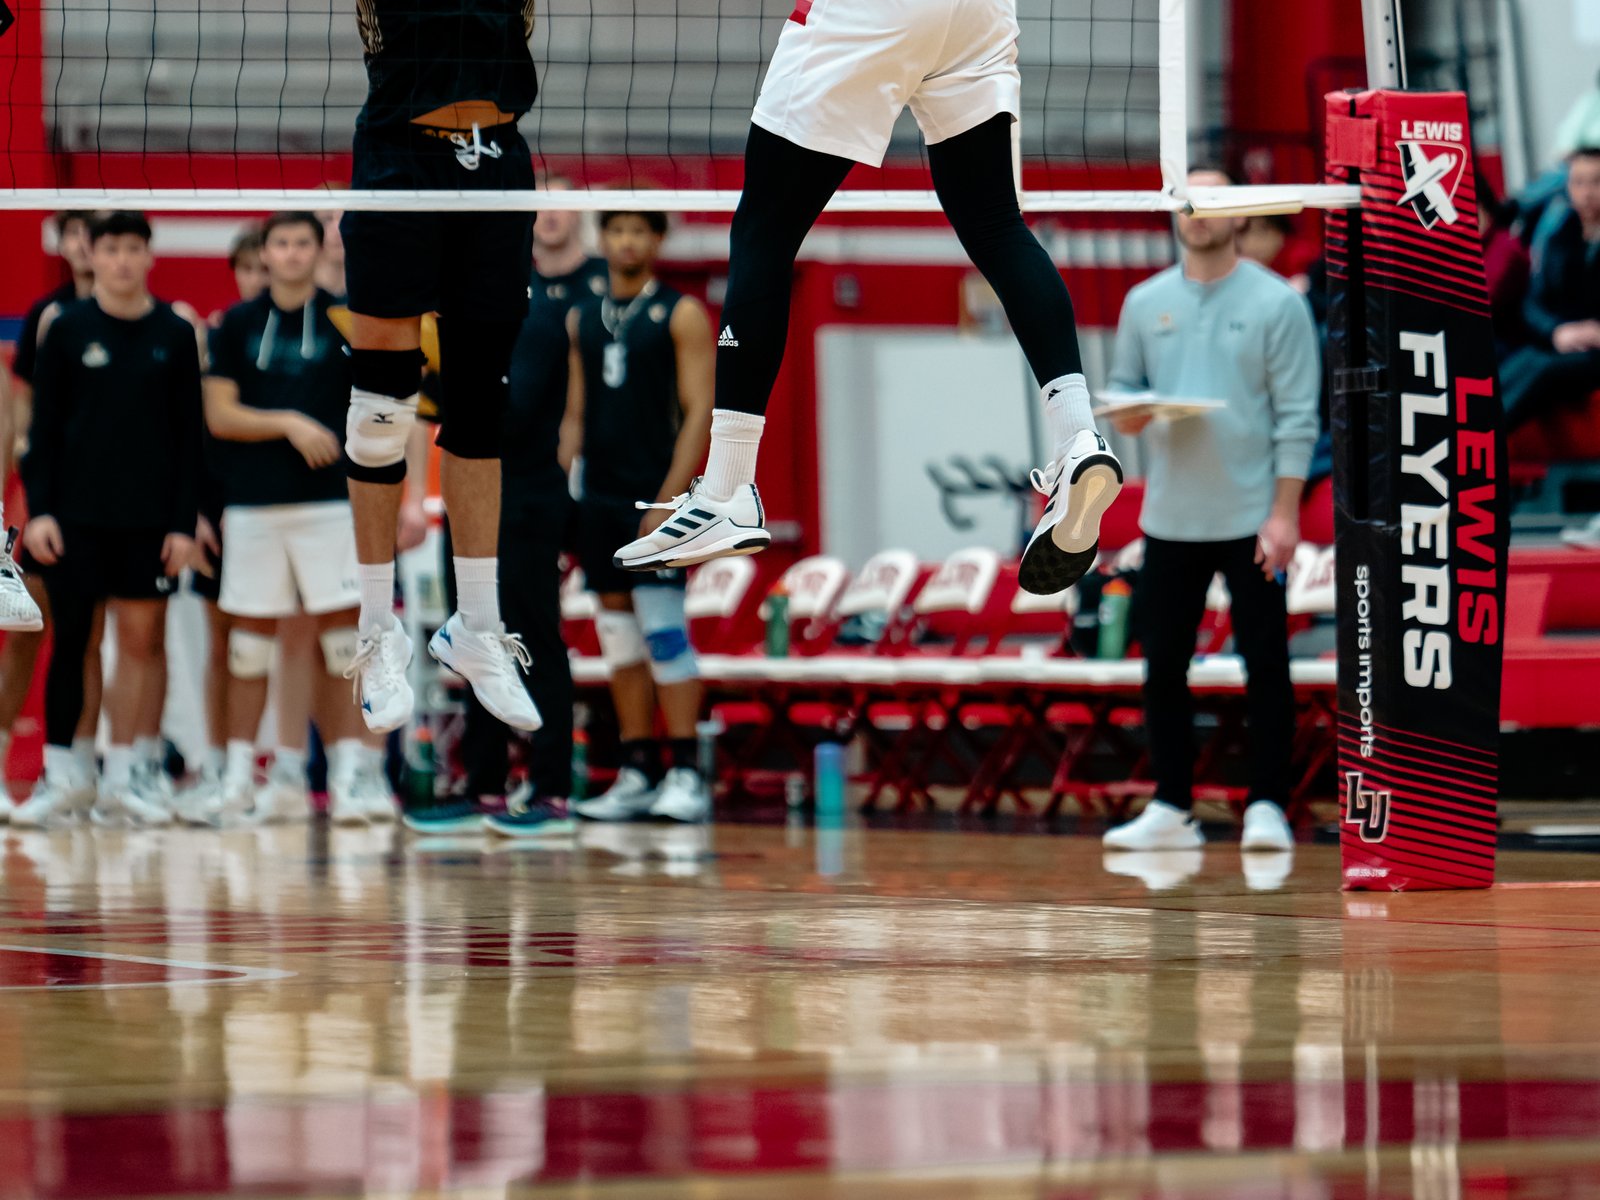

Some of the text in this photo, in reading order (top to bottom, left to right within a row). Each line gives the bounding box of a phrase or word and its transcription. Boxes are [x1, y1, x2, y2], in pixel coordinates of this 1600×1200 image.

[1400, 120, 1463, 142] LEWIS
[1399, 329, 1453, 691] FLYERS
[1455, 376, 1499, 646] LEWIS
[1354, 564, 1376, 759] sports imports
[1345, 771, 1392, 844] LU
